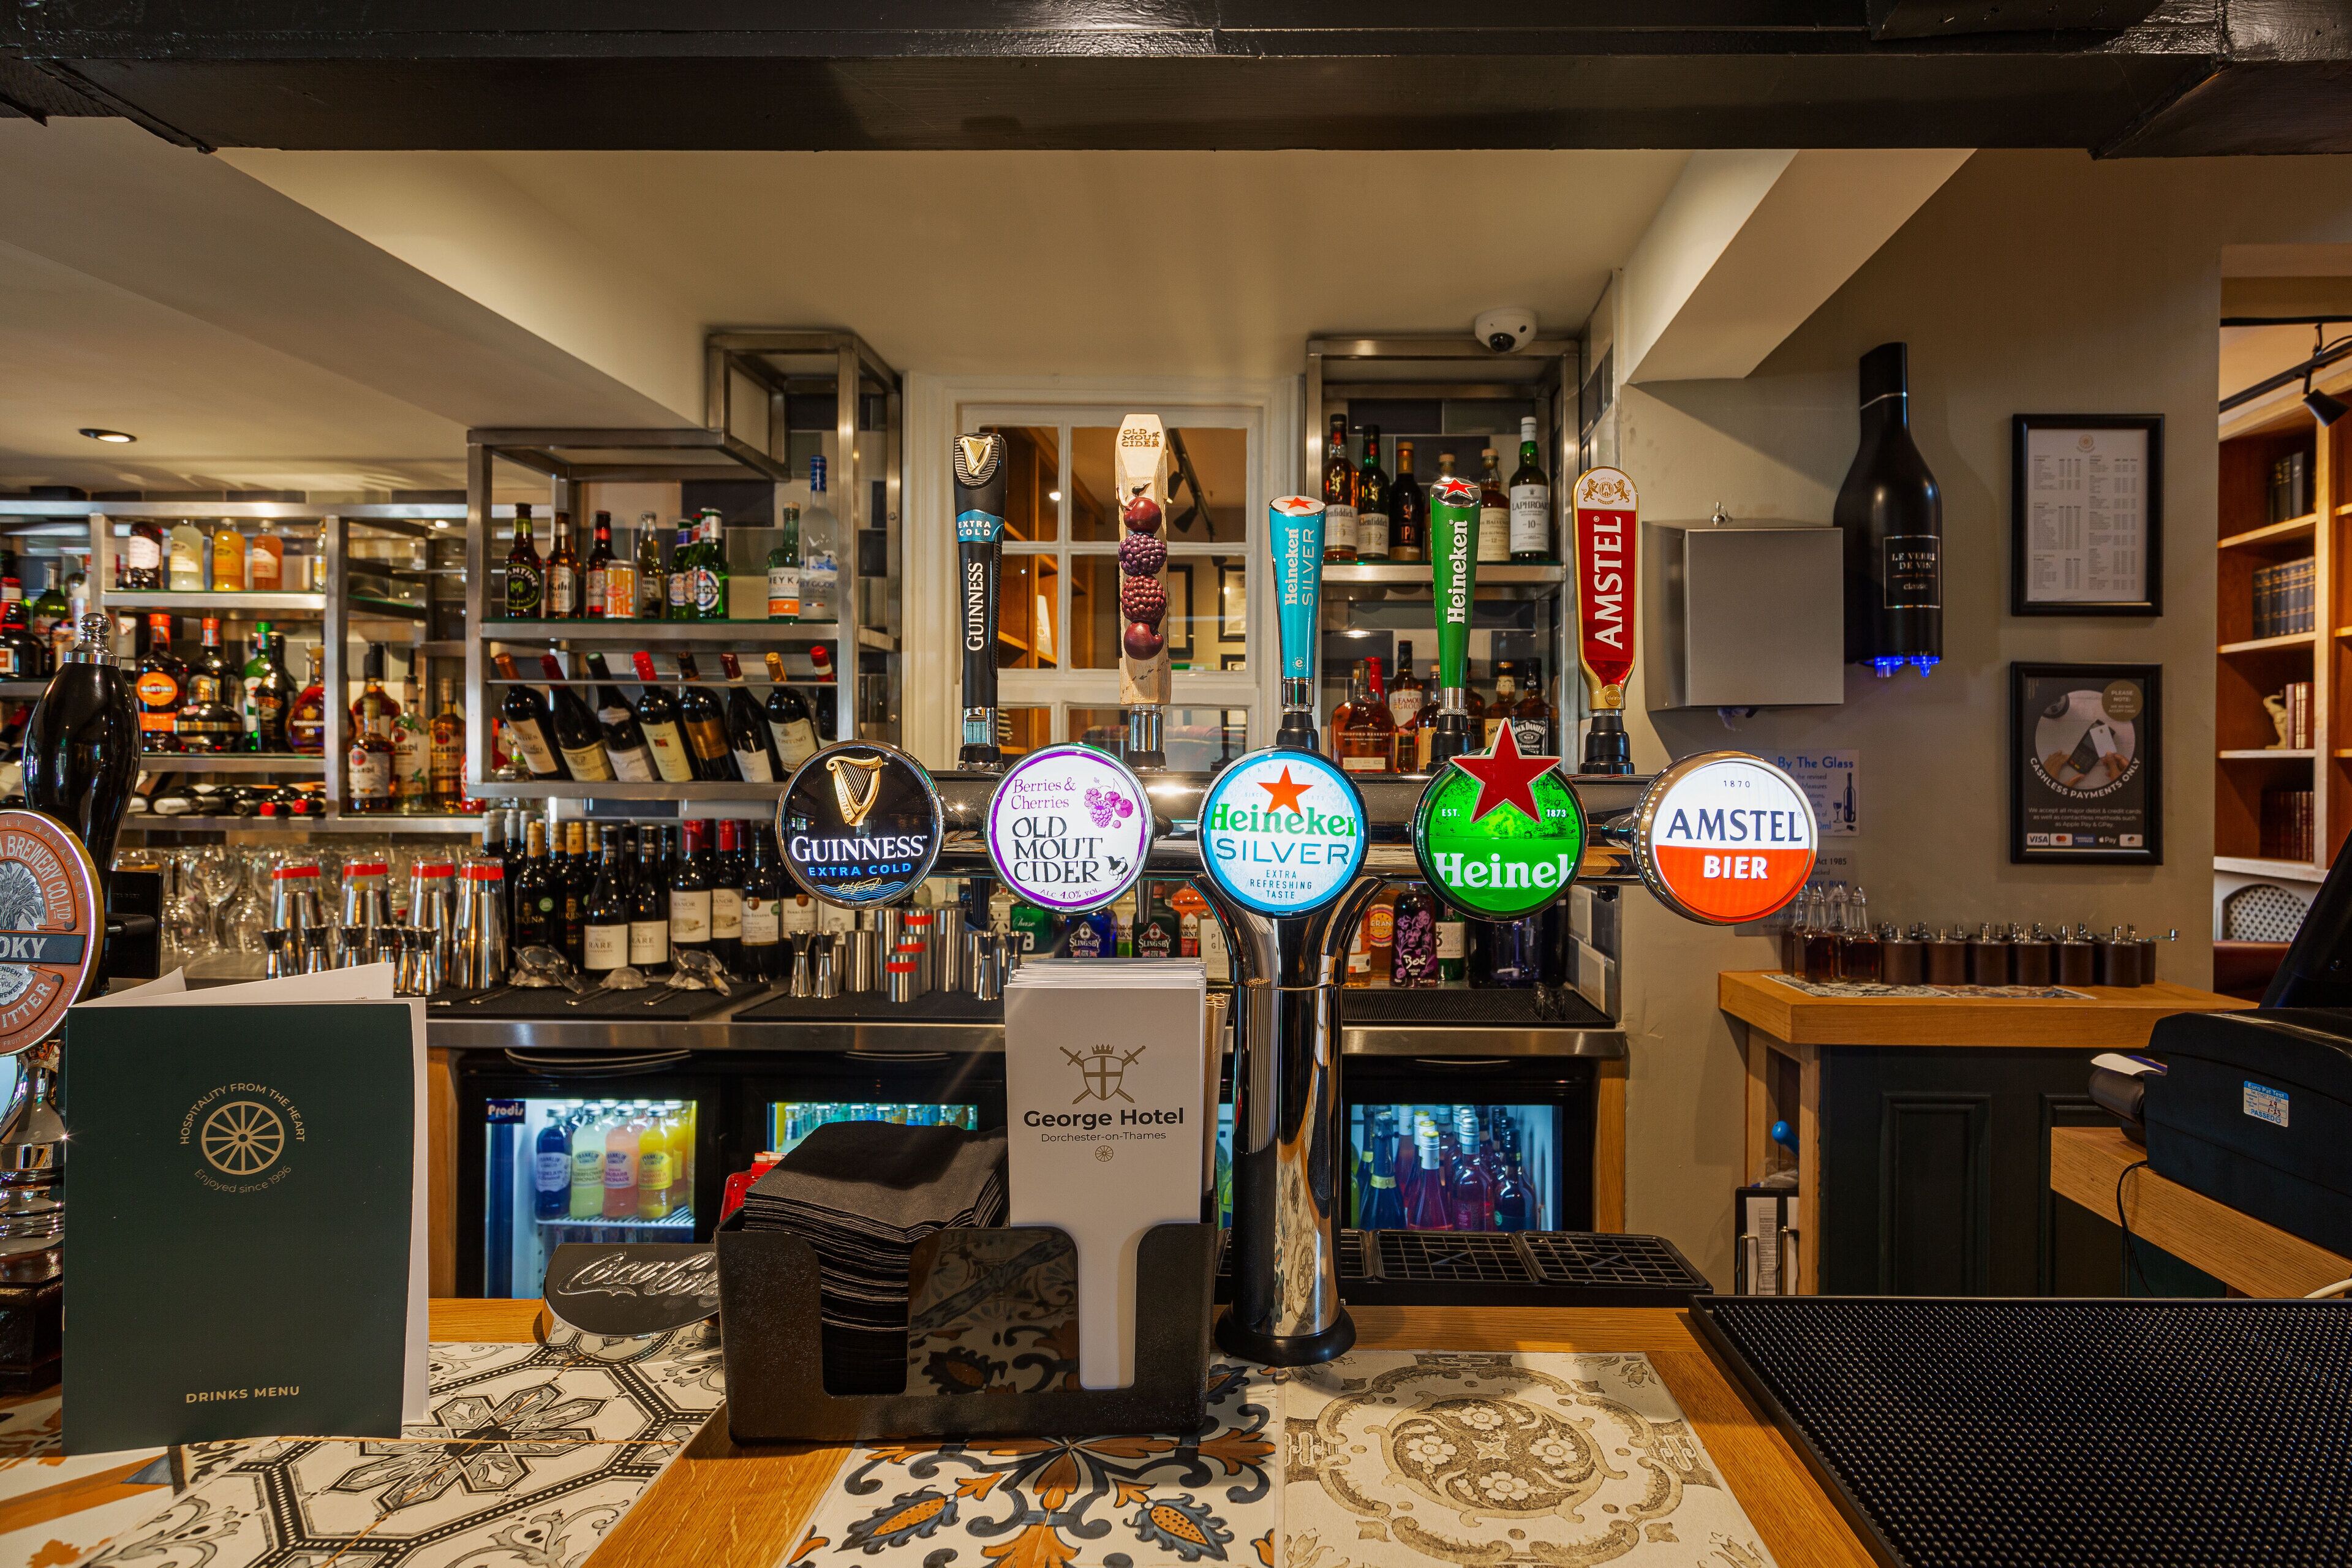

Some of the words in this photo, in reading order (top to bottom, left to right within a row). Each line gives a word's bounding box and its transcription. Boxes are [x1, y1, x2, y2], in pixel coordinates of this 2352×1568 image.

[1122, 432, 1160, 440] MOUT
[1528, 519, 1536, 528] 10
[959, 528, 990, 537] COLD
[1891, 552, 1905, 561] LE
[1284, 528, 1300, 606] Heineken
[1302, 529, 1315, 606] SILVER
[1447, 519, 1468, 624] Heineken
[1899, 561, 1913, 570] DE
[1916, 561, 1932, 570] VIN
[1594, 516, 1623, 650] AMSTEL
[967, 559, 984, 652] GUINNESS
[1777, 756, 1793, 770] By
[1796, 756, 1818, 768] The
[1822, 756, 1854, 769] Glass
[1012, 778, 1061, 794] Berries
[1064, 777, 1077, 791] &
[2030, 757, 2068, 796] CASHLESS
[2070, 780, 2122, 799] PAYMENTS
[2122, 757, 2141, 782] ONLY
[842, 801, 851, 816] 1759
[1011, 795, 1069, 810] Cherries
[1442, 809, 1460, 817] EST.
[1547, 809, 1567, 818] 1873
[1012, 816, 1067, 839] OLD
[1665, 808, 1803, 842] AMSTEL
[791, 835, 927, 862] GUINNESS
[1011, 837, 1102, 859] MOUT
[1216, 838, 1349, 865] SILVER
[6, 835, 63, 882] BREWERY
[34, 824, 86, 899] BALANCED
[808, 866, 861, 876] EXTRA
[869, 862, 912, 875] COLD
[1014, 860, 1102, 883] CIDER
[1266, 869, 1297, 879] EXTRA
[1703, 855, 1768, 880] BIER
[1250, 879, 1312, 889] REFRESHING
[1040, 888, 1057, 899] ALC
[1060, 889, 1082, 900] 4.0%
[1084, 888, 1101, 897] VOL
[1267, 890, 1295, 899] TASTE
[1012, 916, 1036, 929] Chase
[1069, 938, 1101, 948] SLINGSBY
[1138, 939, 1172, 948] SLINGSBY
[1403, 954, 1426, 969] Boë
[2248, 1083, 2261, 1091] Euro
[180, 1085, 226, 1145] HOSPITALITY
[230, 1083, 267, 1095] FROM
[270, 1088, 290, 1107] THE
[287, 1105, 305, 1142] HEART
[488, 1102, 524, 1117] Prodis
[2250, 1109, 2275, 1121] PASSED
[1023, 1109, 1113, 1131] George
[1120, 1107, 1184, 1126] Hotel
[1041, 1131, 1167, 1143] Dorchester-on-Thames
[194, 1169, 237, 1193] Enjoyed
[239, 1181, 268, 1193] since
[268, 1165, 292, 1185] 1996
[186, 1389, 248, 1403] DRINKS
[254, 1385, 300, 1398] MENU
